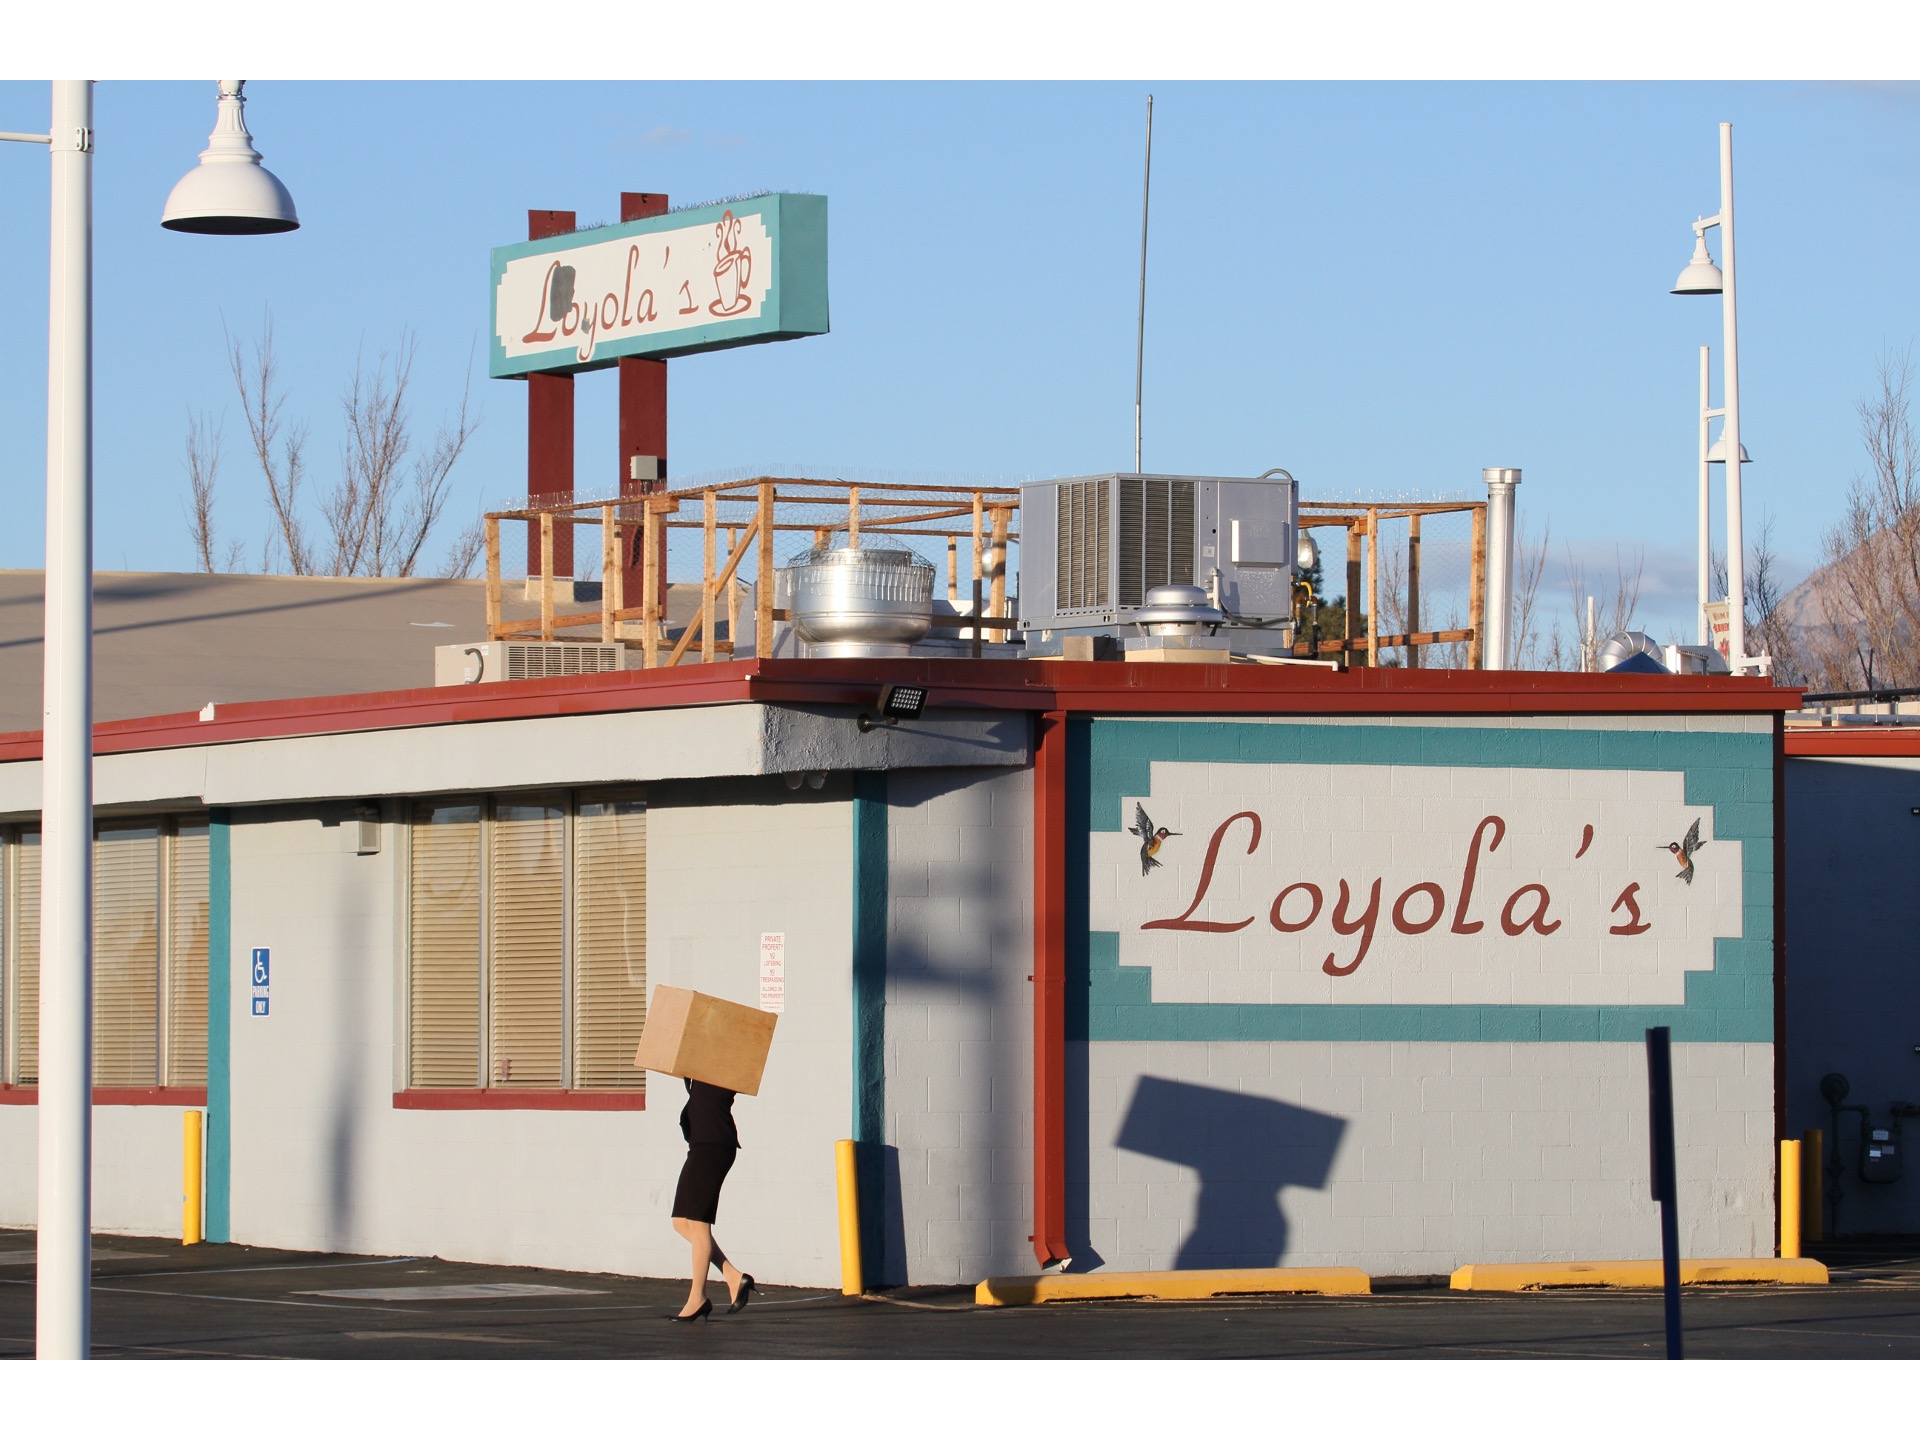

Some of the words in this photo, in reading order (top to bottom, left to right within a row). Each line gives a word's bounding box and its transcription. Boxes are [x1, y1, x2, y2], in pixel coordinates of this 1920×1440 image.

[522, 245, 699, 361] Loyola's
[1141, 811, 1651, 976] Loyola's
[764, 935, 781, 943] PRIVATE
[762, 943, 784, 951] PROPERTY
[252, 985, 269, 998] PARKING
